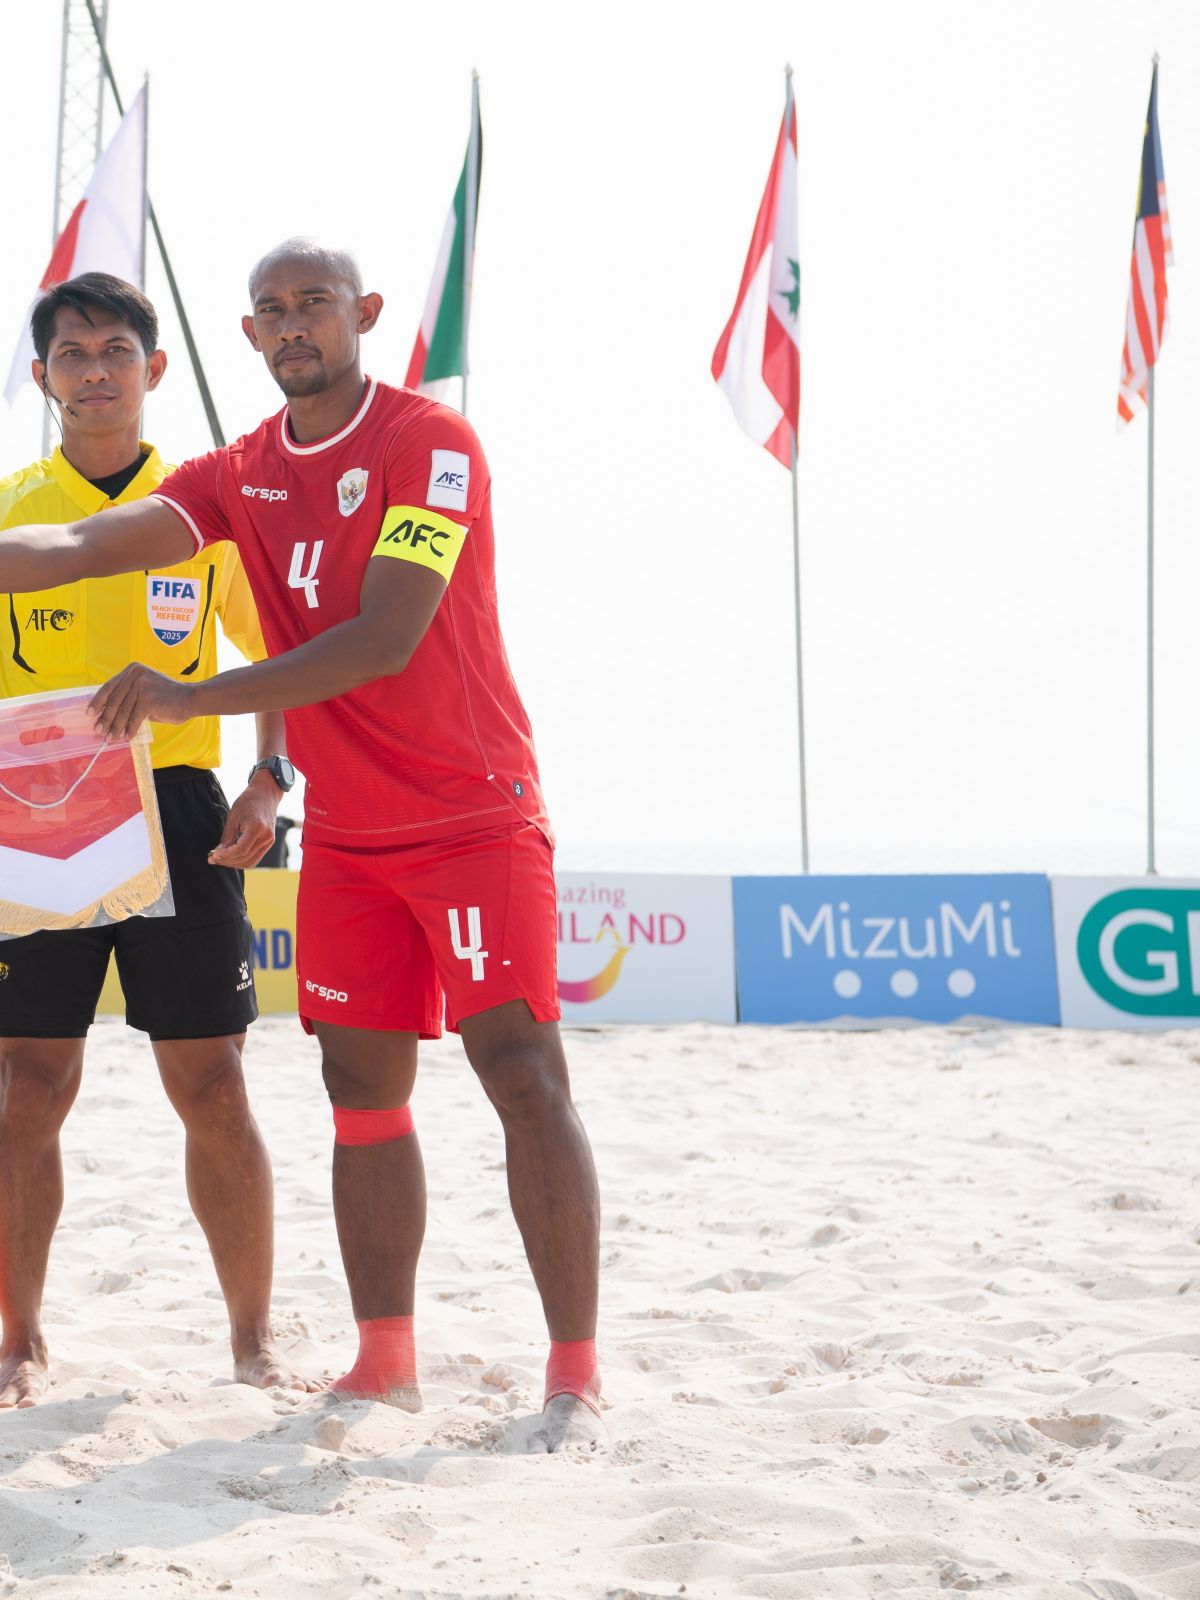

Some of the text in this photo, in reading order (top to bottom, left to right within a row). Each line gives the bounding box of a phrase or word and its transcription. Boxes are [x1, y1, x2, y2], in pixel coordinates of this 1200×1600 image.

[436, 472, 464, 487] AFC
[241, 485, 288, 502] erspo
[383, 519, 451, 558] AFC
[287, 539, 324, 608] 4
[152, 581, 195, 599] FIFA
[25, 608, 74, 631] AFC
[157, 613, 191, 621] REFEREE
[161, 632, 181, 640] 2025
[557, 882, 626, 909] azing
[557, 912, 686, 945] ILAND
[780, 901, 1021, 958] MizuMi
[448, 906, 489, 981] 4
[305, 980, 348, 1003] erspo
